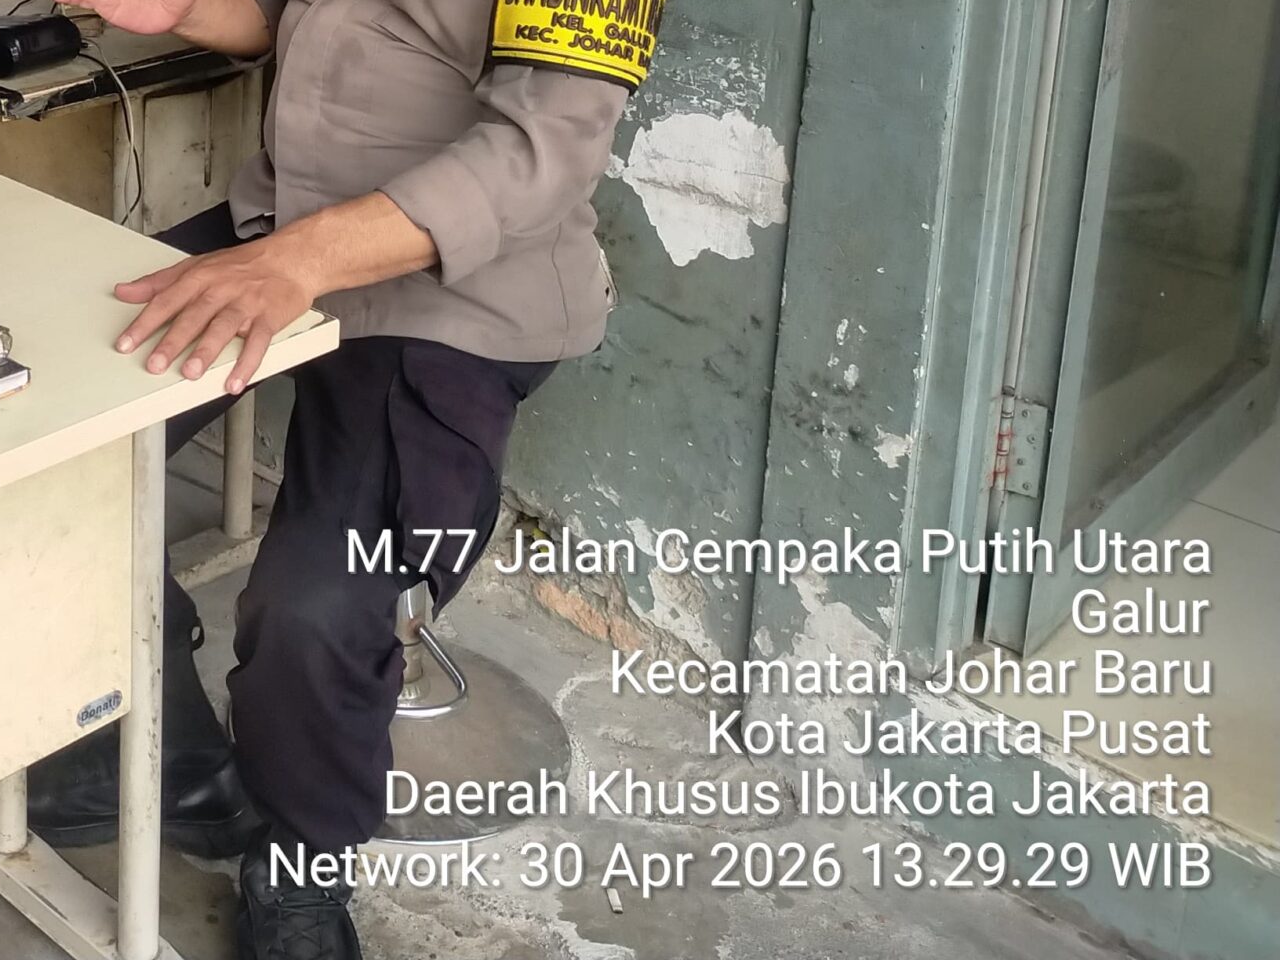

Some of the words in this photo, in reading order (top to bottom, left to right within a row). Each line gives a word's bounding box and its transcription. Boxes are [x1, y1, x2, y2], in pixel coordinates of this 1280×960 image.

[550, 11, 594, 34] KEL.
[514, 23, 559, 45] KEC.
[568, 33, 634, 63] JOHAR
